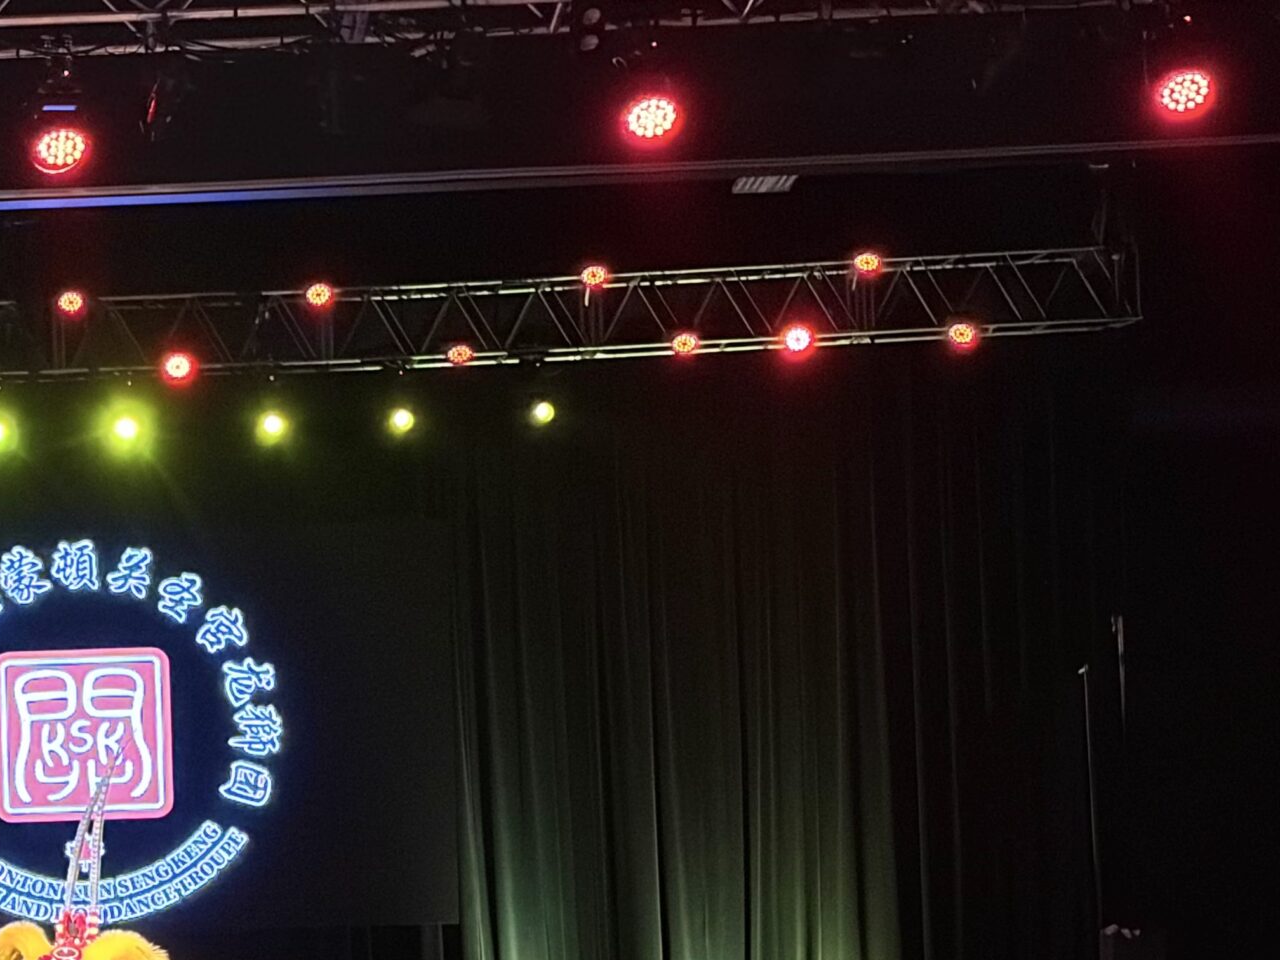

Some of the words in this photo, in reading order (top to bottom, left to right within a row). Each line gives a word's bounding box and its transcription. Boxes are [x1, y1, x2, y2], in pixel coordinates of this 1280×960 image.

[41, 719, 126, 768] KSK
[1, 893, 51, 921] AND
[107, 884, 180, 922] DANCE
[175, 828, 249, 896] TROUPE
[116, 860, 172, 896] SENG
[167, 821, 222, 873] KENG
